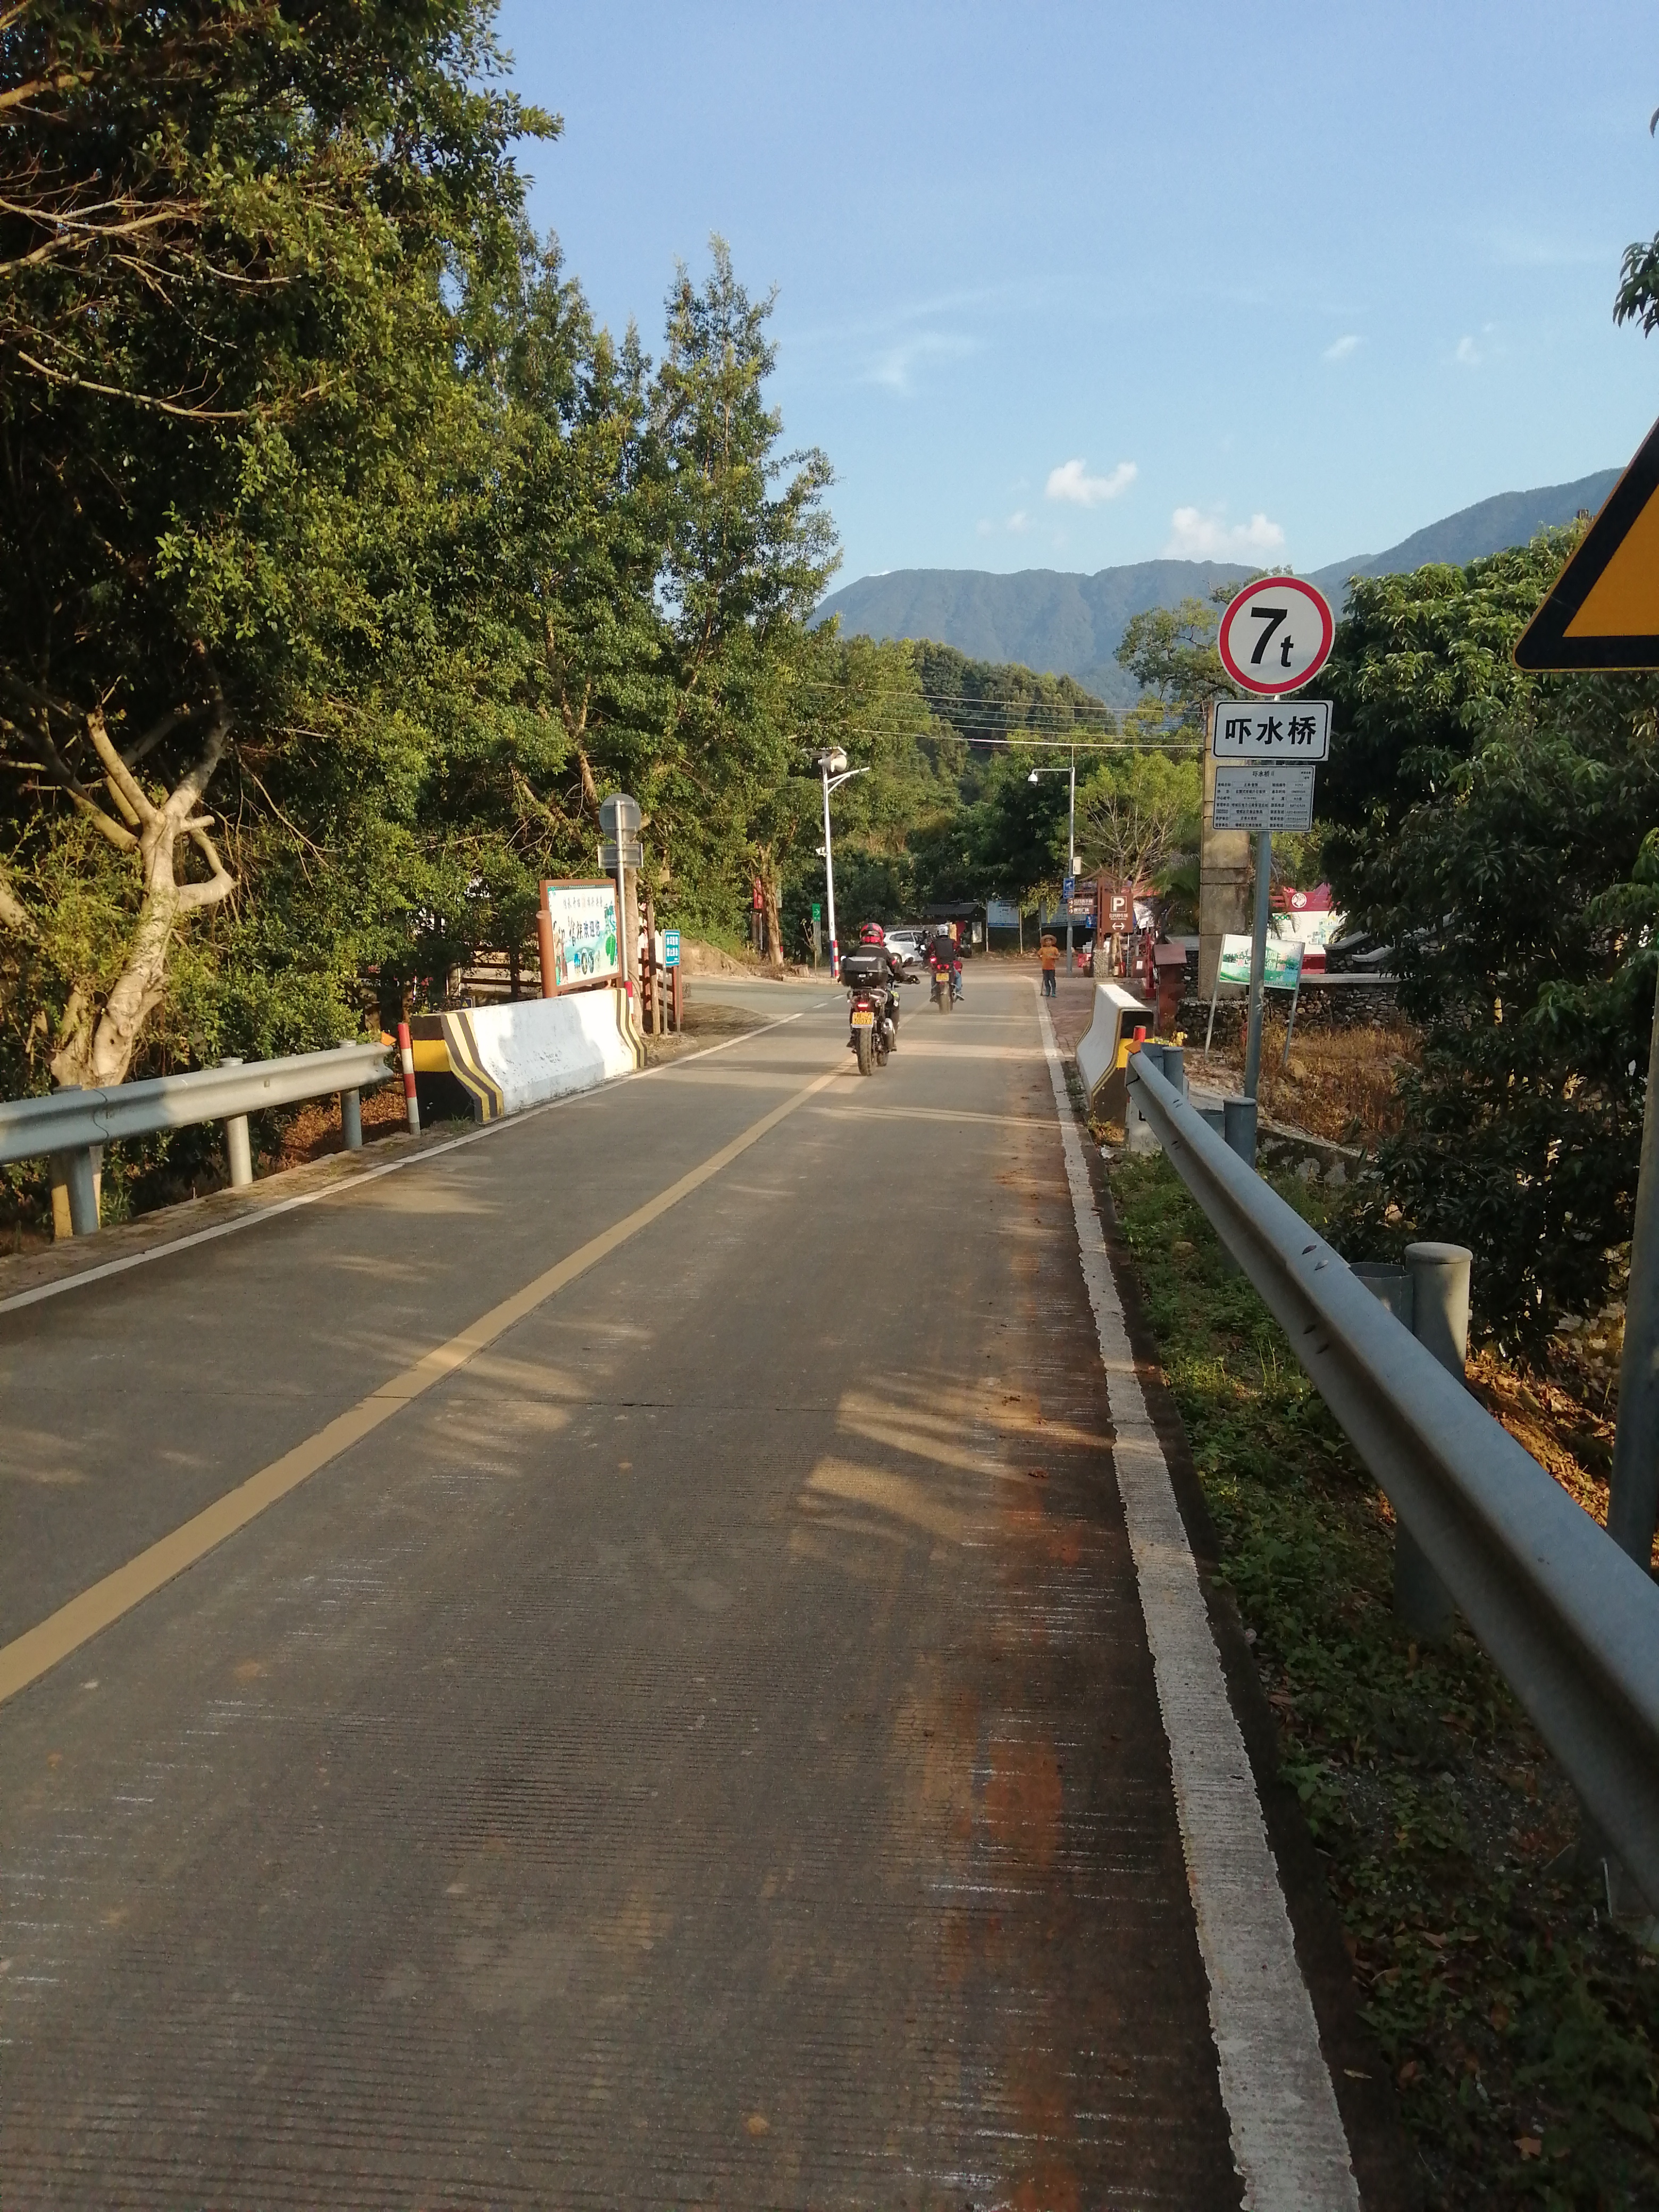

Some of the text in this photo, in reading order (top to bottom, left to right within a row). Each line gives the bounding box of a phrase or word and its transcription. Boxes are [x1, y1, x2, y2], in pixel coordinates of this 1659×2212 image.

[1251, 607, 1294, 667] 7t
[1225, 716, 1317, 745] 吓水桥
[1113, 897, 1125, 911] P
